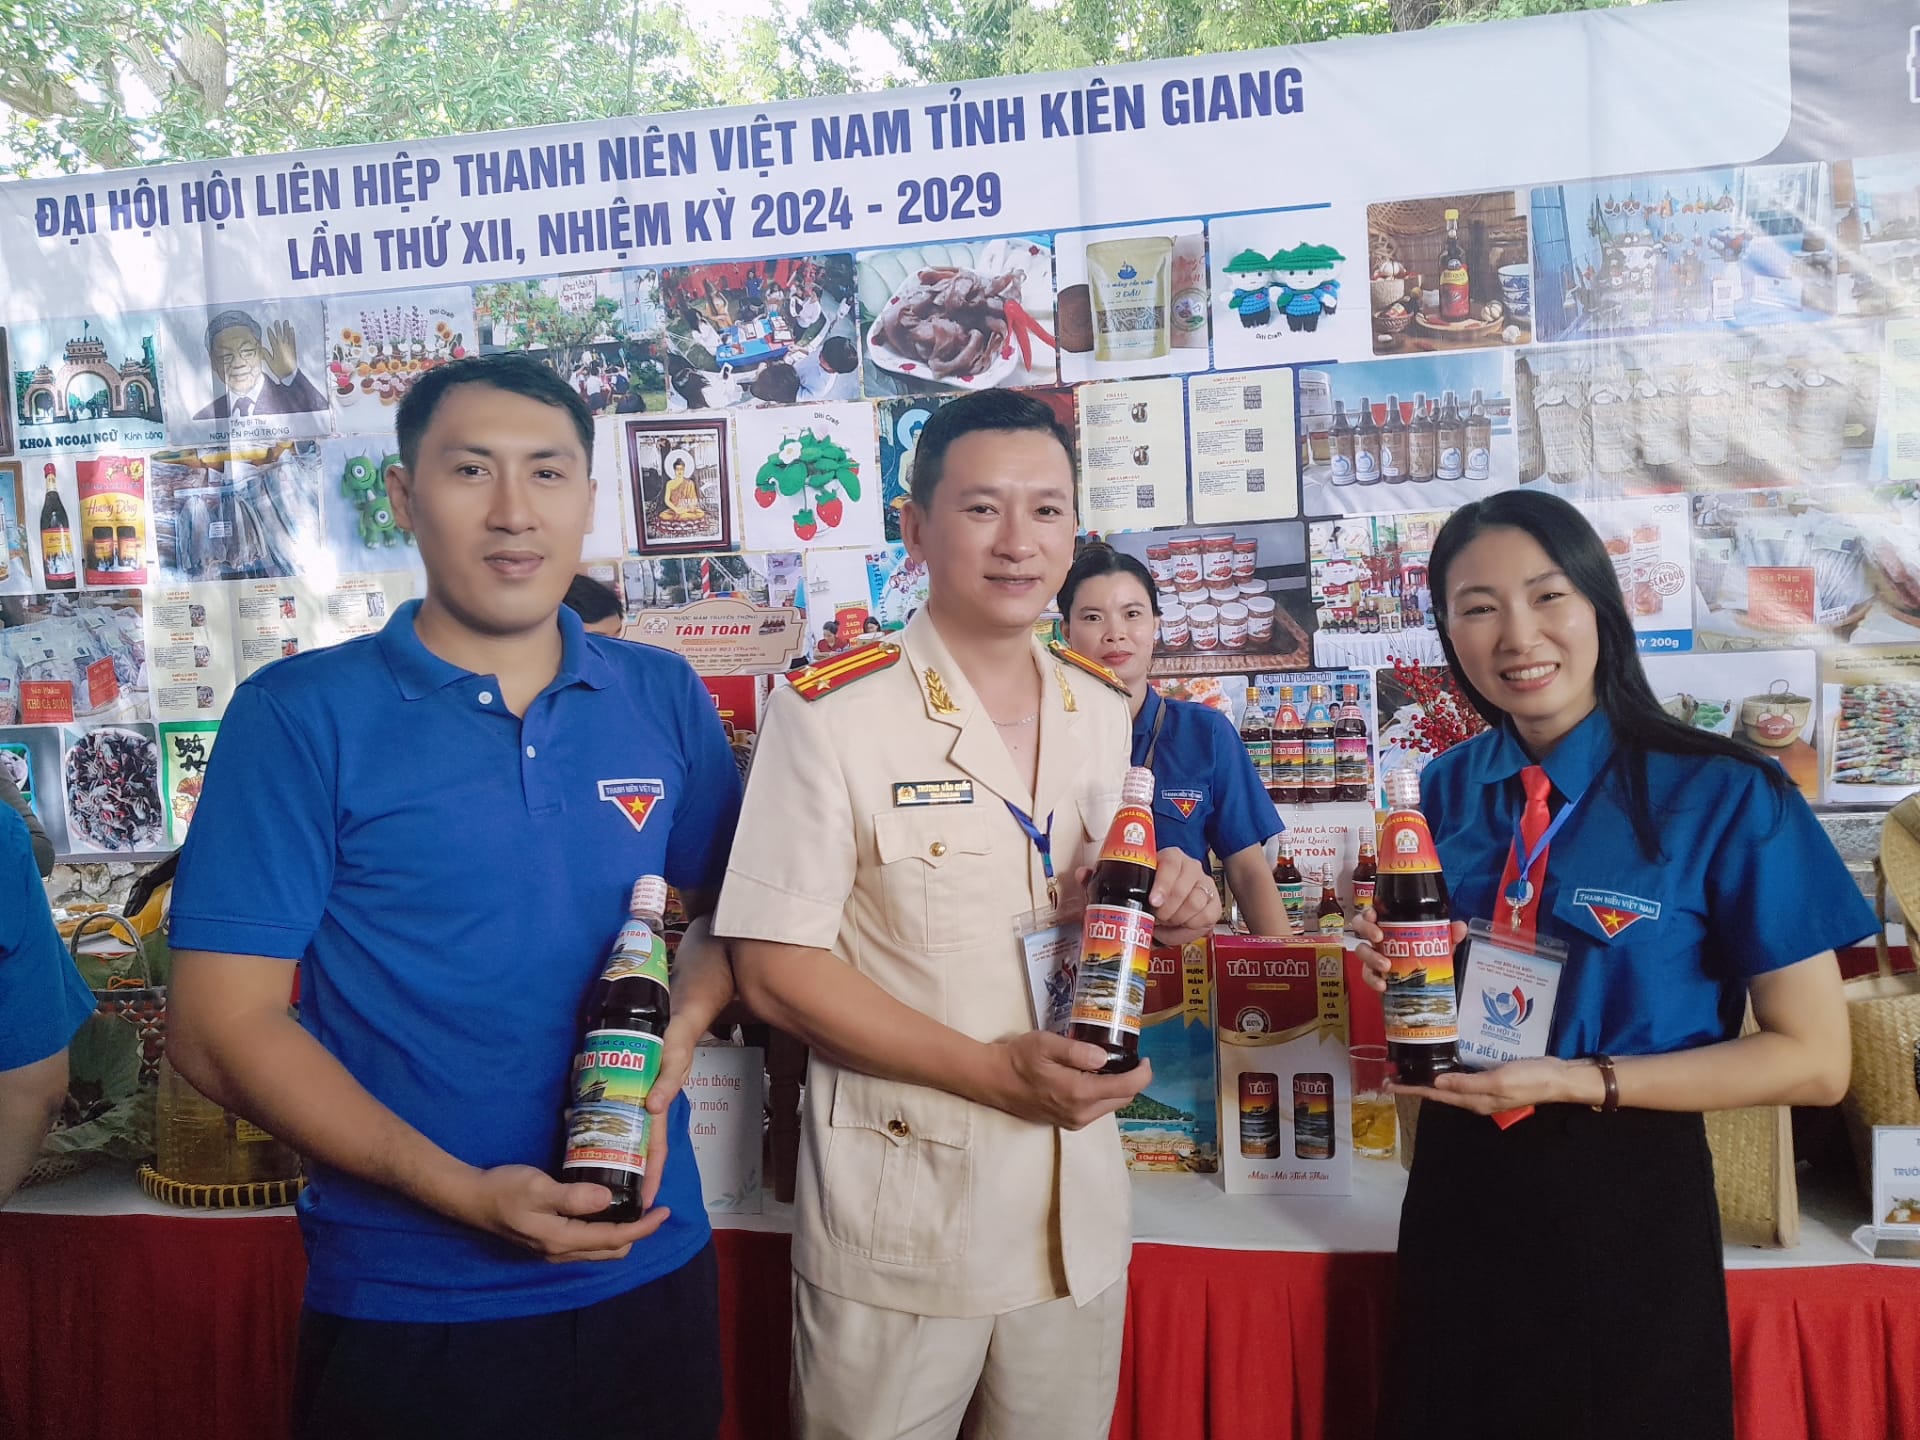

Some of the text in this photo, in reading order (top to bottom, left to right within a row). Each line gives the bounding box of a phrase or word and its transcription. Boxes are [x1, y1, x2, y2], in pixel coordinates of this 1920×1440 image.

[35, 66, 1305, 246] ĐẠI HỘI HỘI LIÊN HIỆP THANH NIÊN VIỆT NAM TỈNH KIÊN GIANG
[288, 219, 364, 281] LẦN
[373, 214, 453, 272] THỨ
[461, 216, 527, 266] XII,
[537, 197, 672, 261] NHIỆM
[684, 186, 737, 244] KỲ
[749, 187, 854, 239] 2024
[896, 170, 1003, 226] 2029
[20, 438, 53, 450] KHOA
[55, 435, 93, 448] NGOẠI
[93, 428, 119, 442] NGỮ
[675, 622, 752, 637] TÂN TOÀN
[1649, 637, 1681, 649] 200g
[1314, 825, 1327, 834] CÁ
[1306, 846, 1337, 857] TOÀN
[1088, 920, 1153, 950] TÂN TOÀN
[1383, 937, 1450, 958] TÂN TOÀN
[1226, 958, 1310, 977] TÂN TOÀN
[599, 1049, 645, 1072] TOÀN
[711, 1073, 741, 1091] thống
[700, 1097, 729, 1112] muốn
